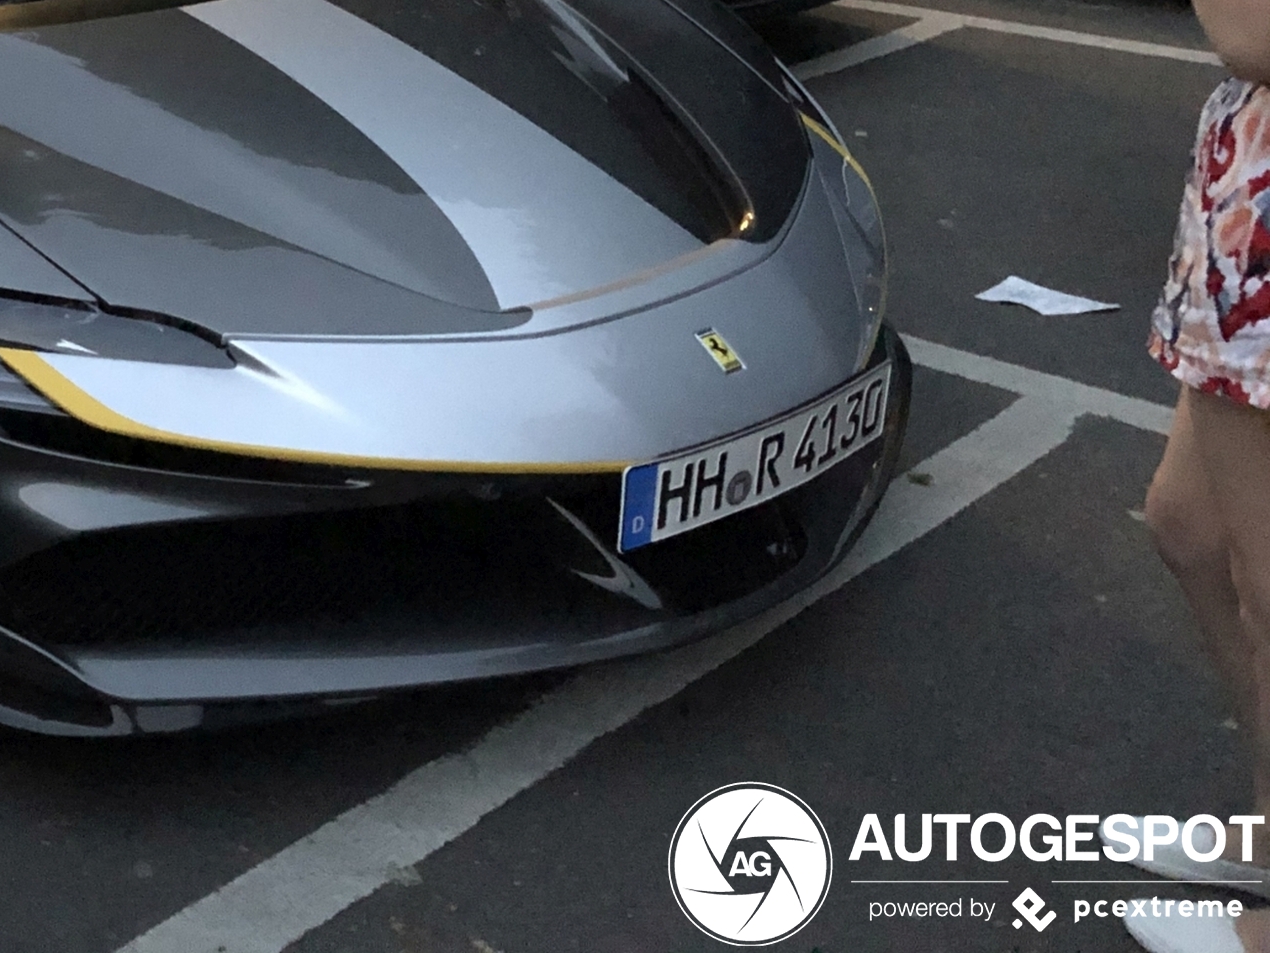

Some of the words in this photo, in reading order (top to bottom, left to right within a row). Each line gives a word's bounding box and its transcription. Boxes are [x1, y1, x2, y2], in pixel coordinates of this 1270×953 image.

[632, 516, 645, 534] D
[657, 451, 728, 530] HH
[755, 431, 785, 496] R
[793, 378, 883, 473] 4130
